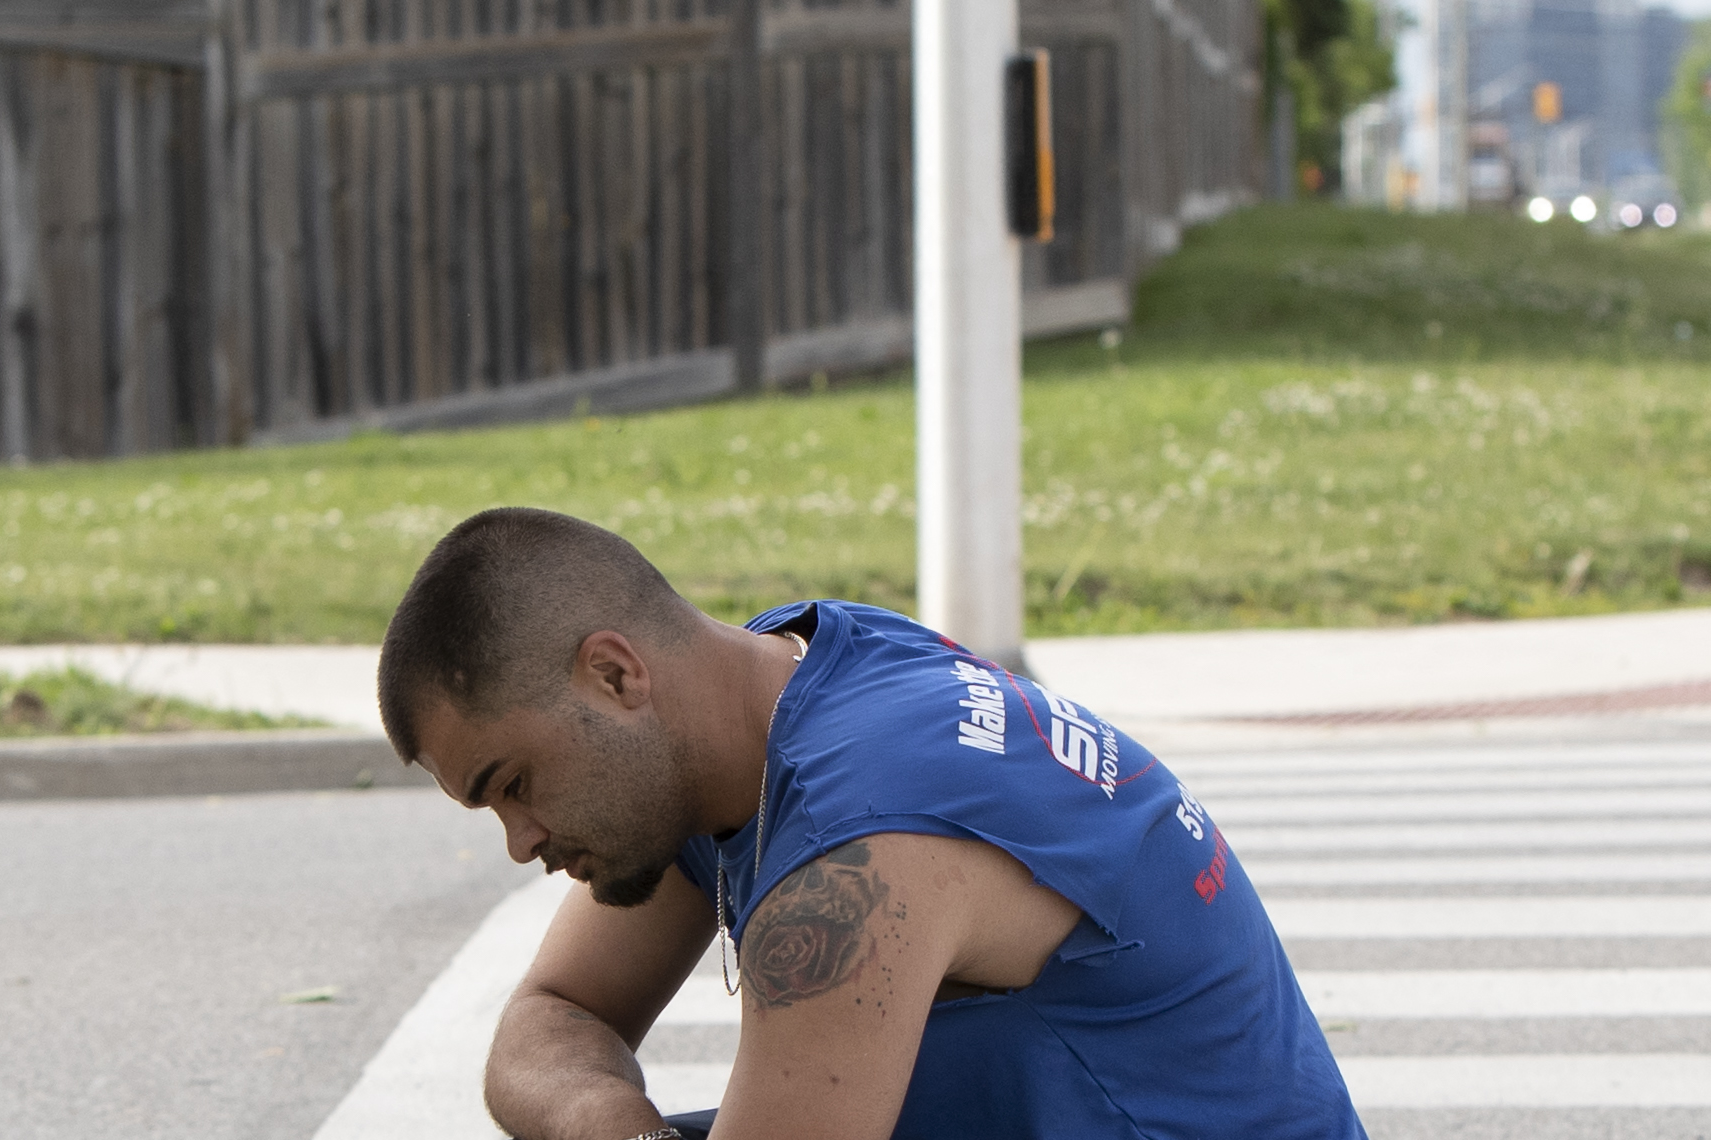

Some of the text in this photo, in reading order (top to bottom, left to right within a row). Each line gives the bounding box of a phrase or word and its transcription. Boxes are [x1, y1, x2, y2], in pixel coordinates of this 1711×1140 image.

[950, 660, 1006, 755] Make the
[1100, 724, 1119, 800] MOVING
